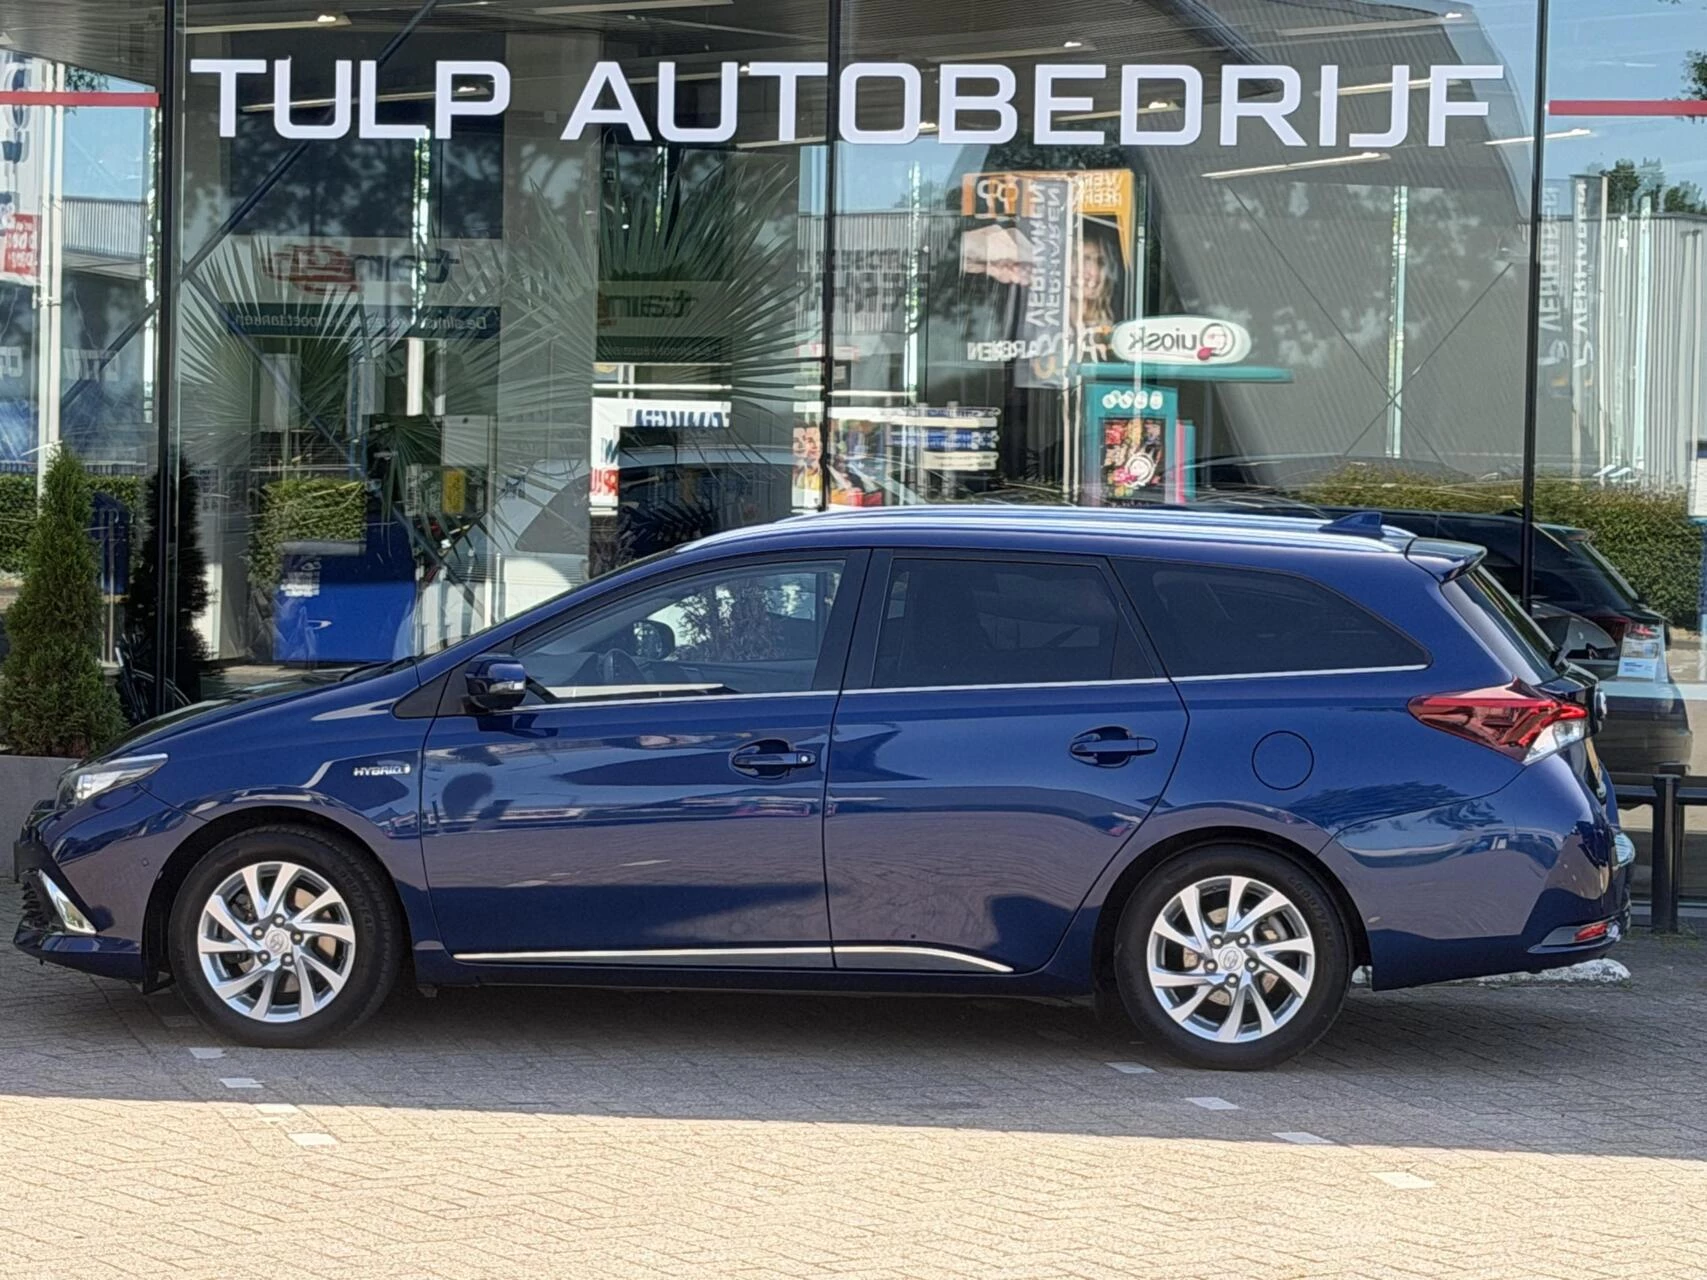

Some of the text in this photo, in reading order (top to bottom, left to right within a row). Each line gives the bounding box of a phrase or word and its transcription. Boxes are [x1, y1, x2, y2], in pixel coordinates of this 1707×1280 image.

[190, 59, 1504, 147] TULP AUTOBEDRIJF
[353, 766, 402, 776] HYBRID
